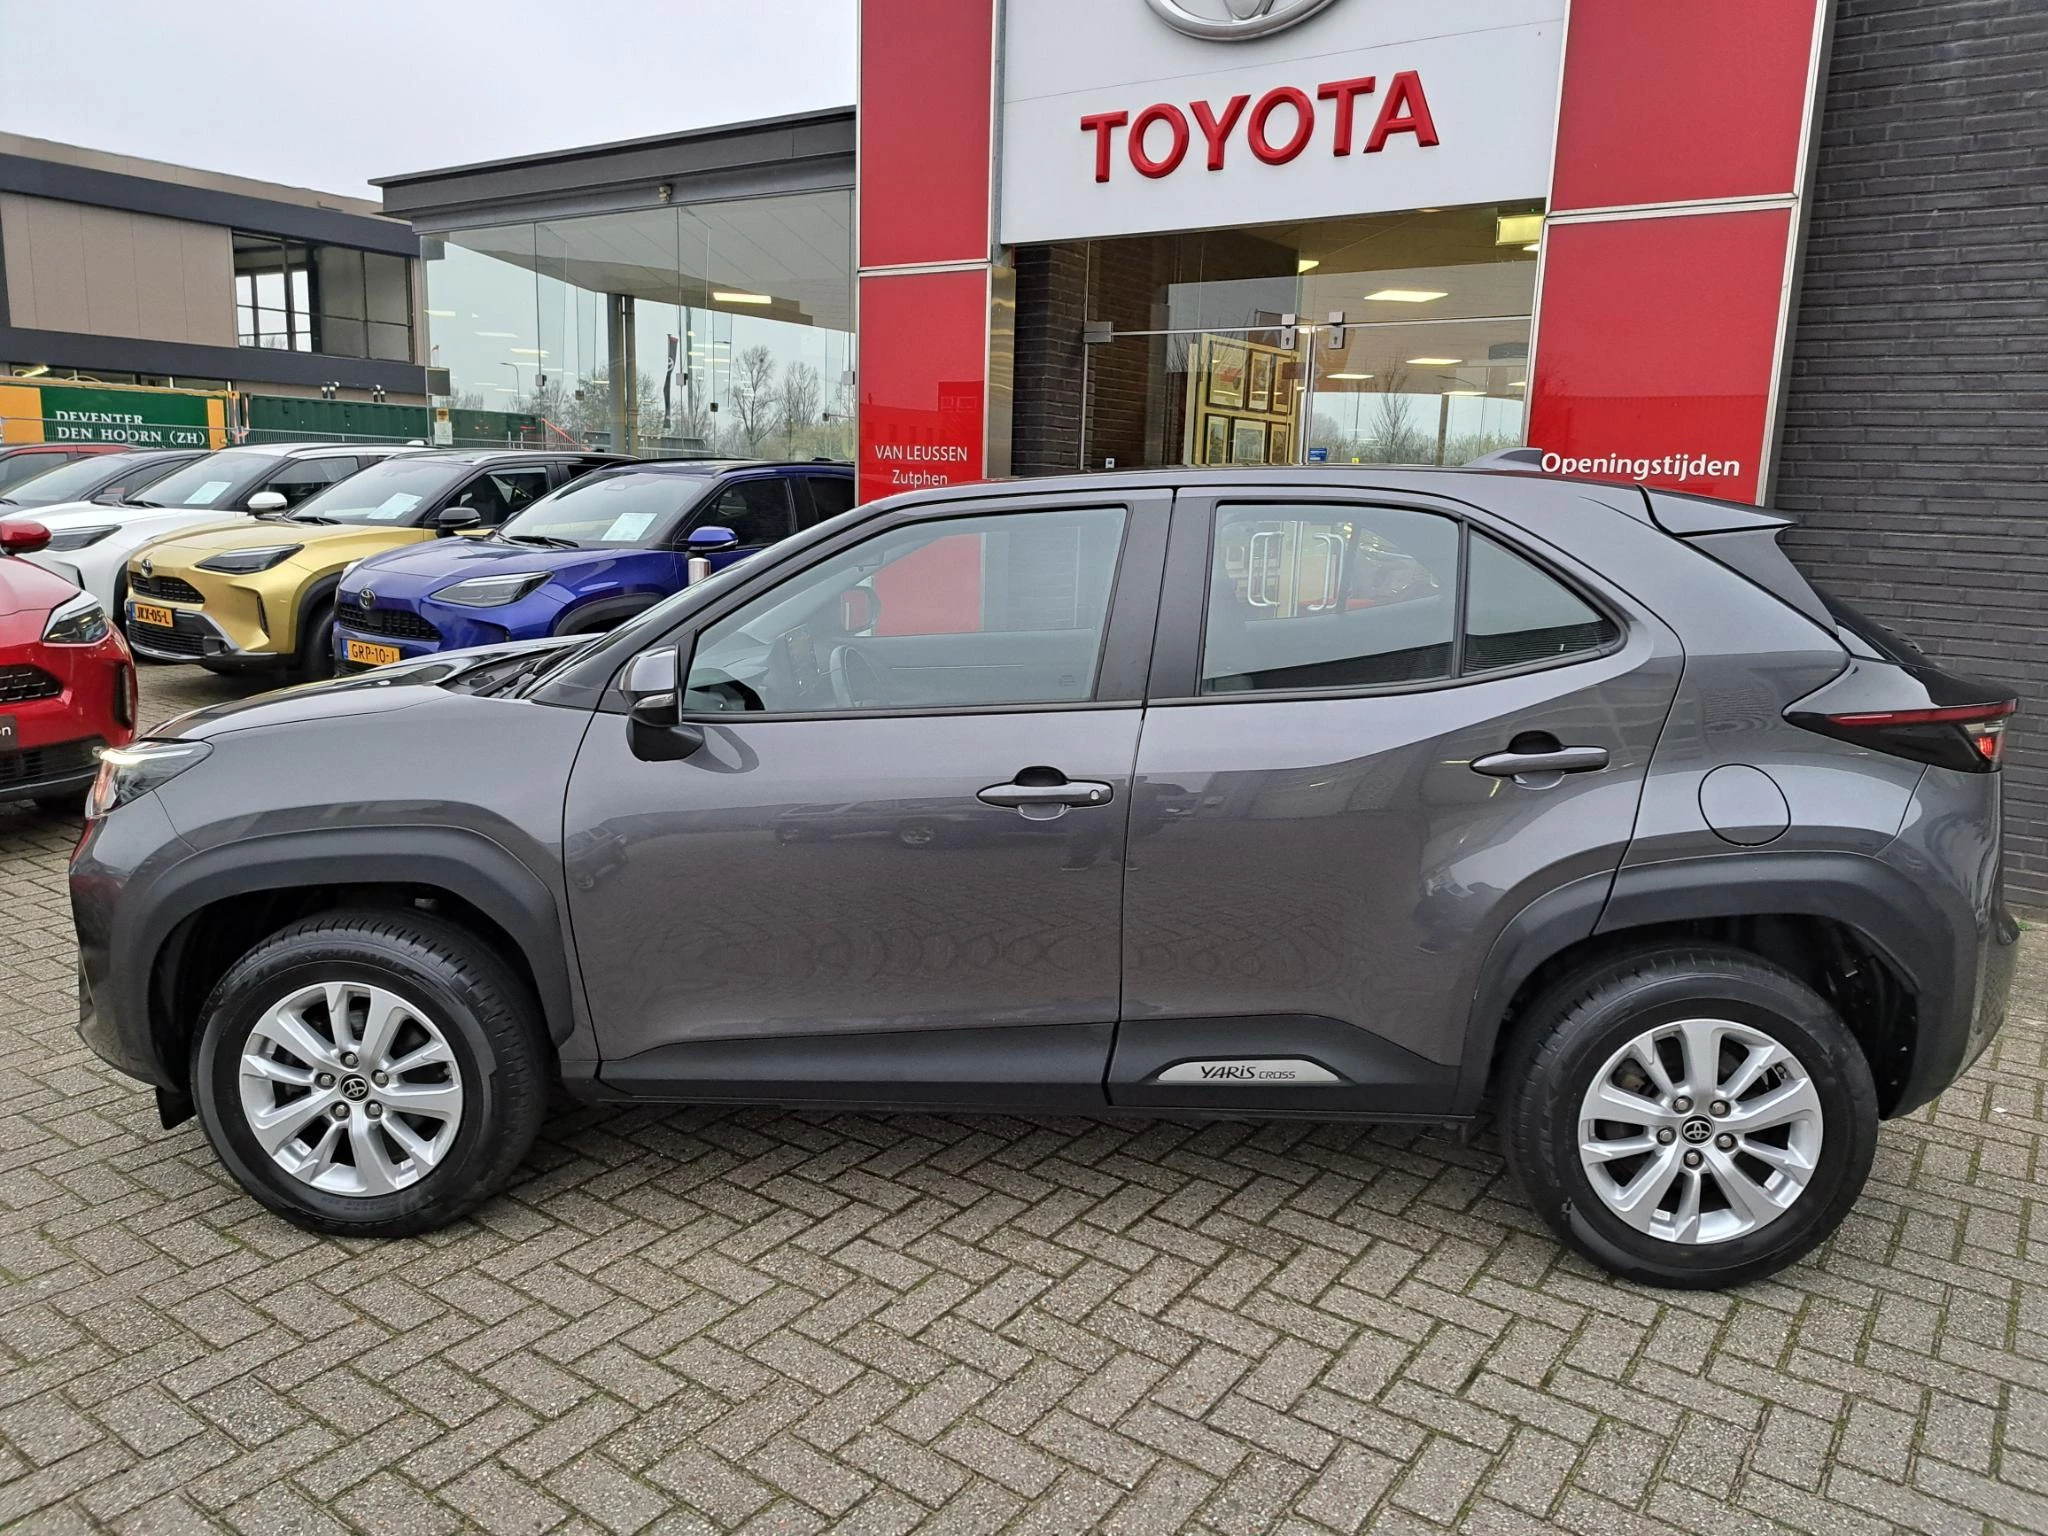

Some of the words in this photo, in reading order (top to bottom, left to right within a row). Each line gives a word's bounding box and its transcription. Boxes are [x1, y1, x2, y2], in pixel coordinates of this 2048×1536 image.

[1081, 70, 1440, 183] TOYOTA
[56, 410, 143, 424] DEVENTER
[57, 427, 93, 439] DEN
[101, 428, 162, 442] HOORN
[169, 431, 205, 445] (ZH)
[875, 445, 902, 460] VAN
[906, 445, 968, 461] LEUSSEN
[1541, 452, 1740, 482] Openingstijden
[892, 469, 948, 488] Zutphen
[1258, 1070, 1296, 1080] CROSS
